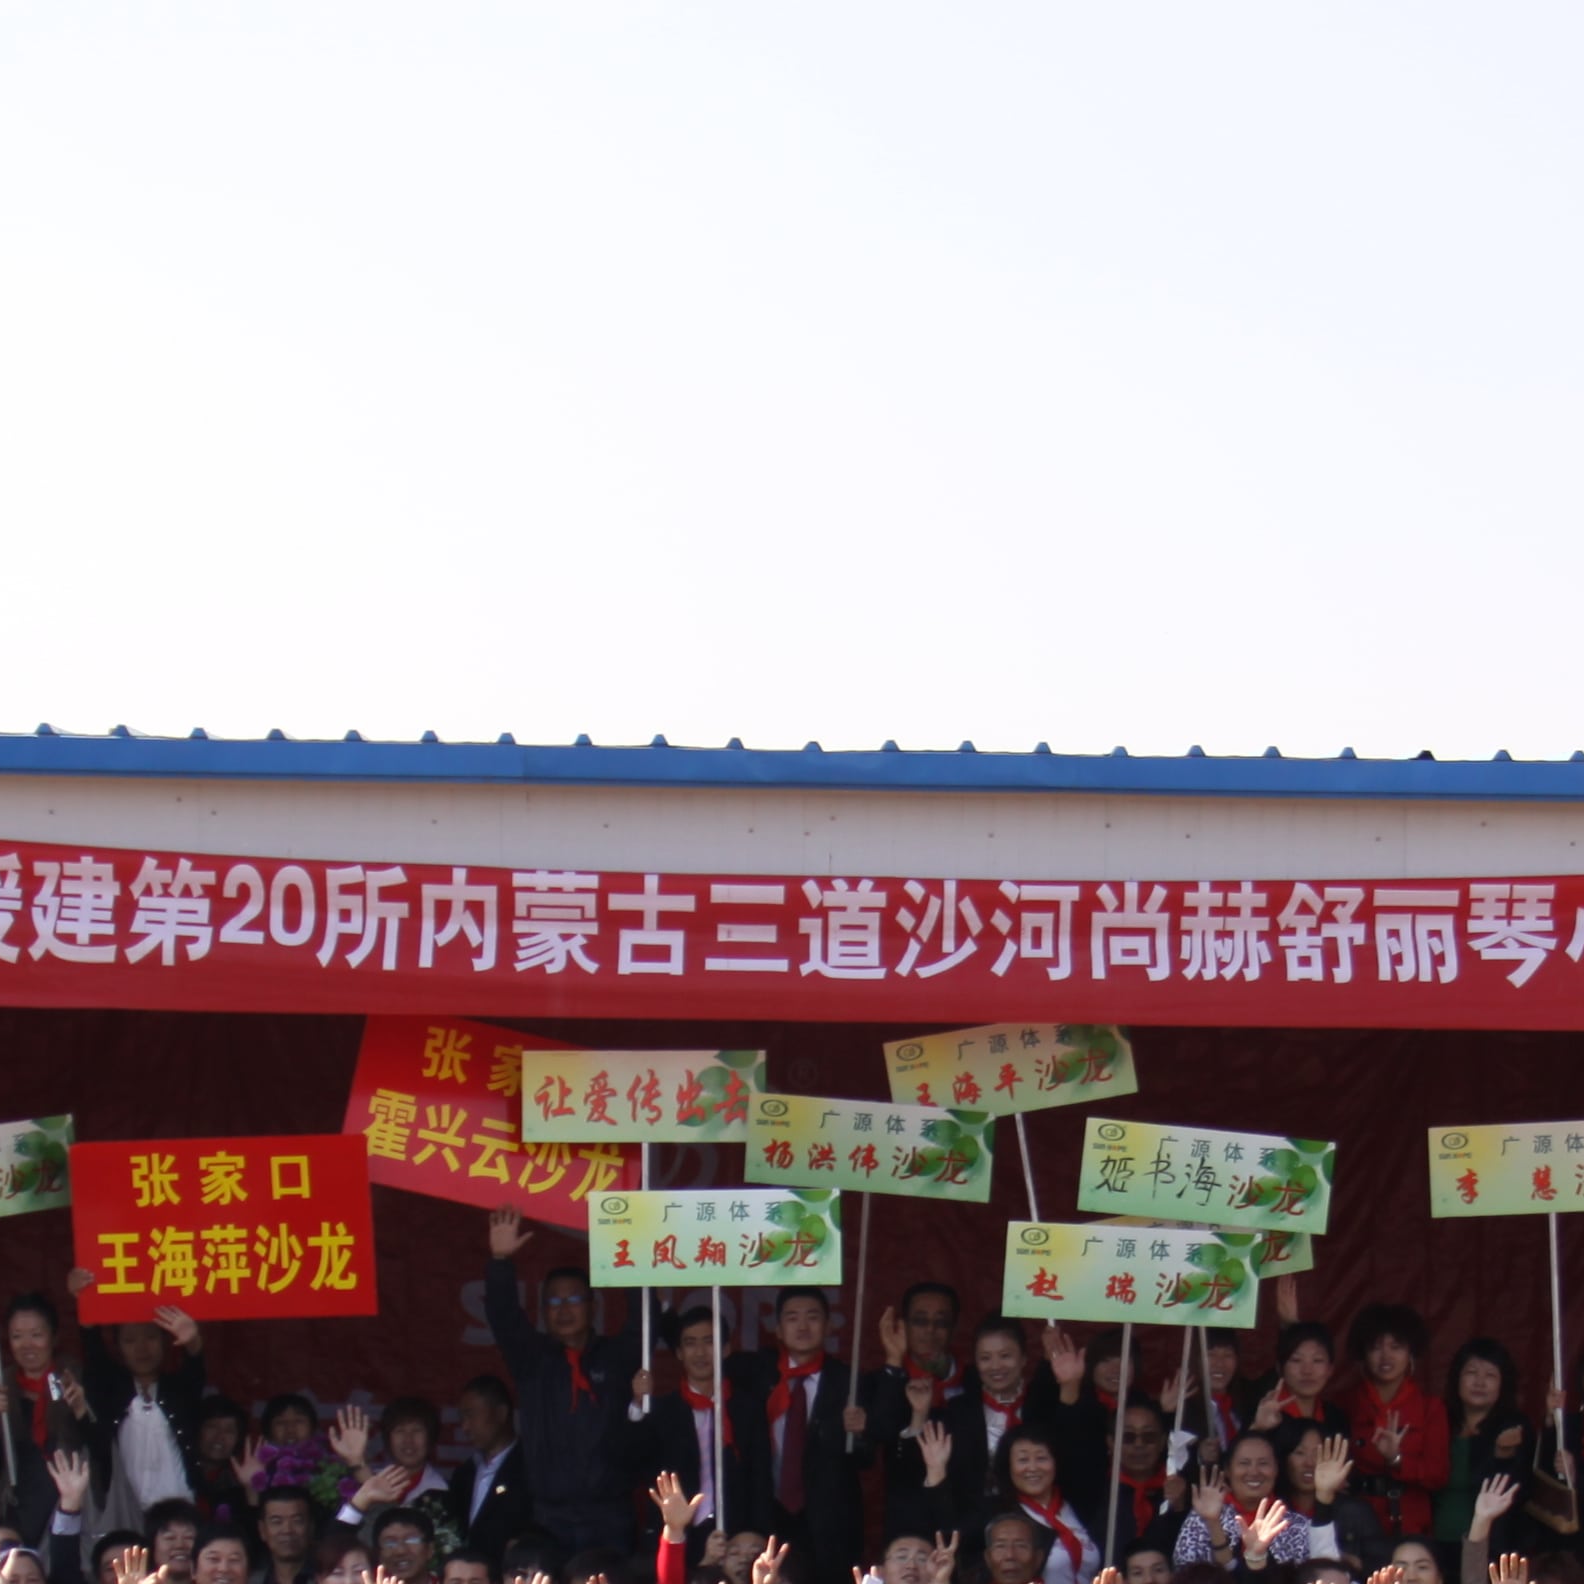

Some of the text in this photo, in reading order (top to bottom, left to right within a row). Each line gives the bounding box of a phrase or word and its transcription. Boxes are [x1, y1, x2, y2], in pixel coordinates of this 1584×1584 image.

[533, 1067, 751, 1127] 让爱传出去
[819, 1110, 938, 1139] 广源体系
[129, 1151, 311, 1208] 张家口
[663, 1200, 783, 1223] 广源体系
[97, 1222, 358, 1297] 王海萍沙龙
[1082, 1236, 1203, 1262] 广源体系
